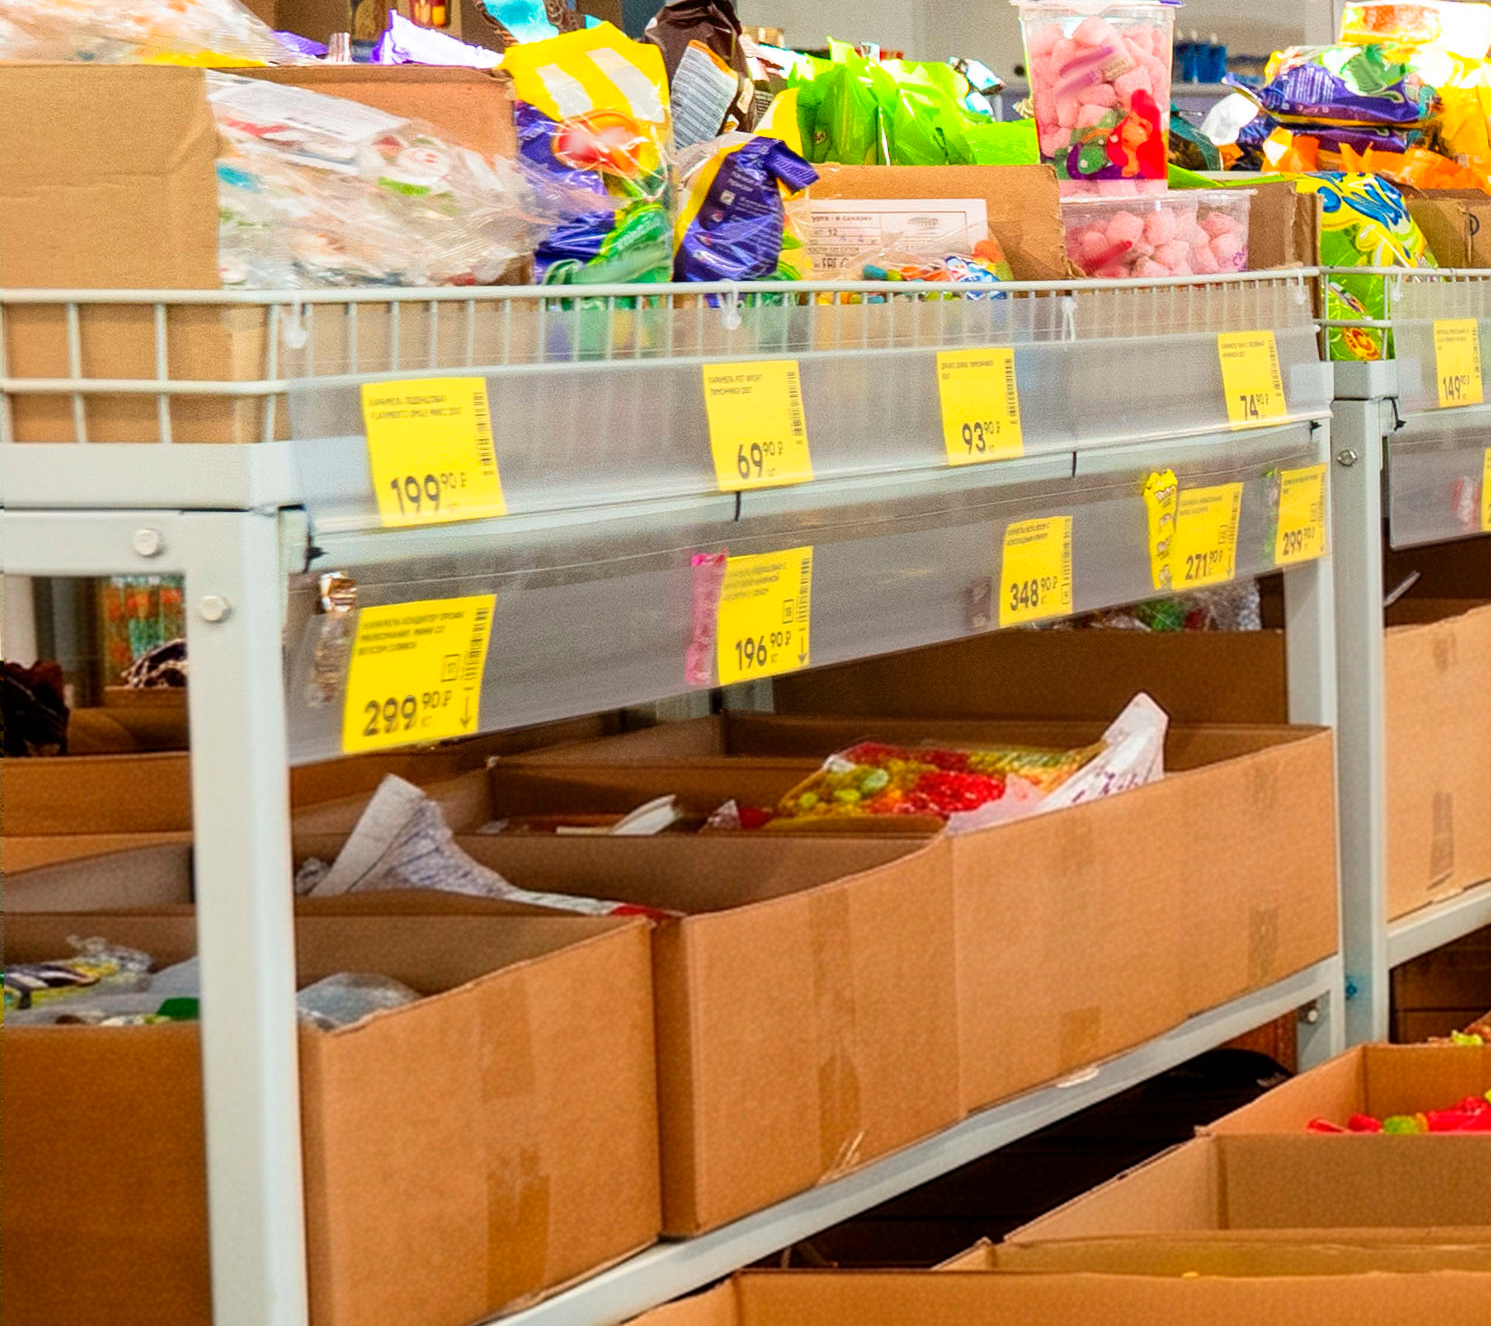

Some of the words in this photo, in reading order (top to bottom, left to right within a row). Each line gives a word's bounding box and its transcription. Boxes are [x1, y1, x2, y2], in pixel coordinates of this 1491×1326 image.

[1240, 395, 1259, 420] 74
[962, 421, 985, 455] 93
[984, 421, 995, 435] 90
[737, 442, 763, 479] 69
[763, 441, 776, 456] 90
[390, 473, 441, 516] 199
[441, 471, 457, 490] 90
[1283, 529, 1302, 557] 299
[1185, 552, 1210, 581] 271
[1010, 578, 1039, 611] 348
[1040, 576, 1051, 593] 90
[735, 635, 768, 671] 196
[770, 632, 783, 649] 90
[363, 693, 417, 737] 299
[422, 691, 440, 710] 90
